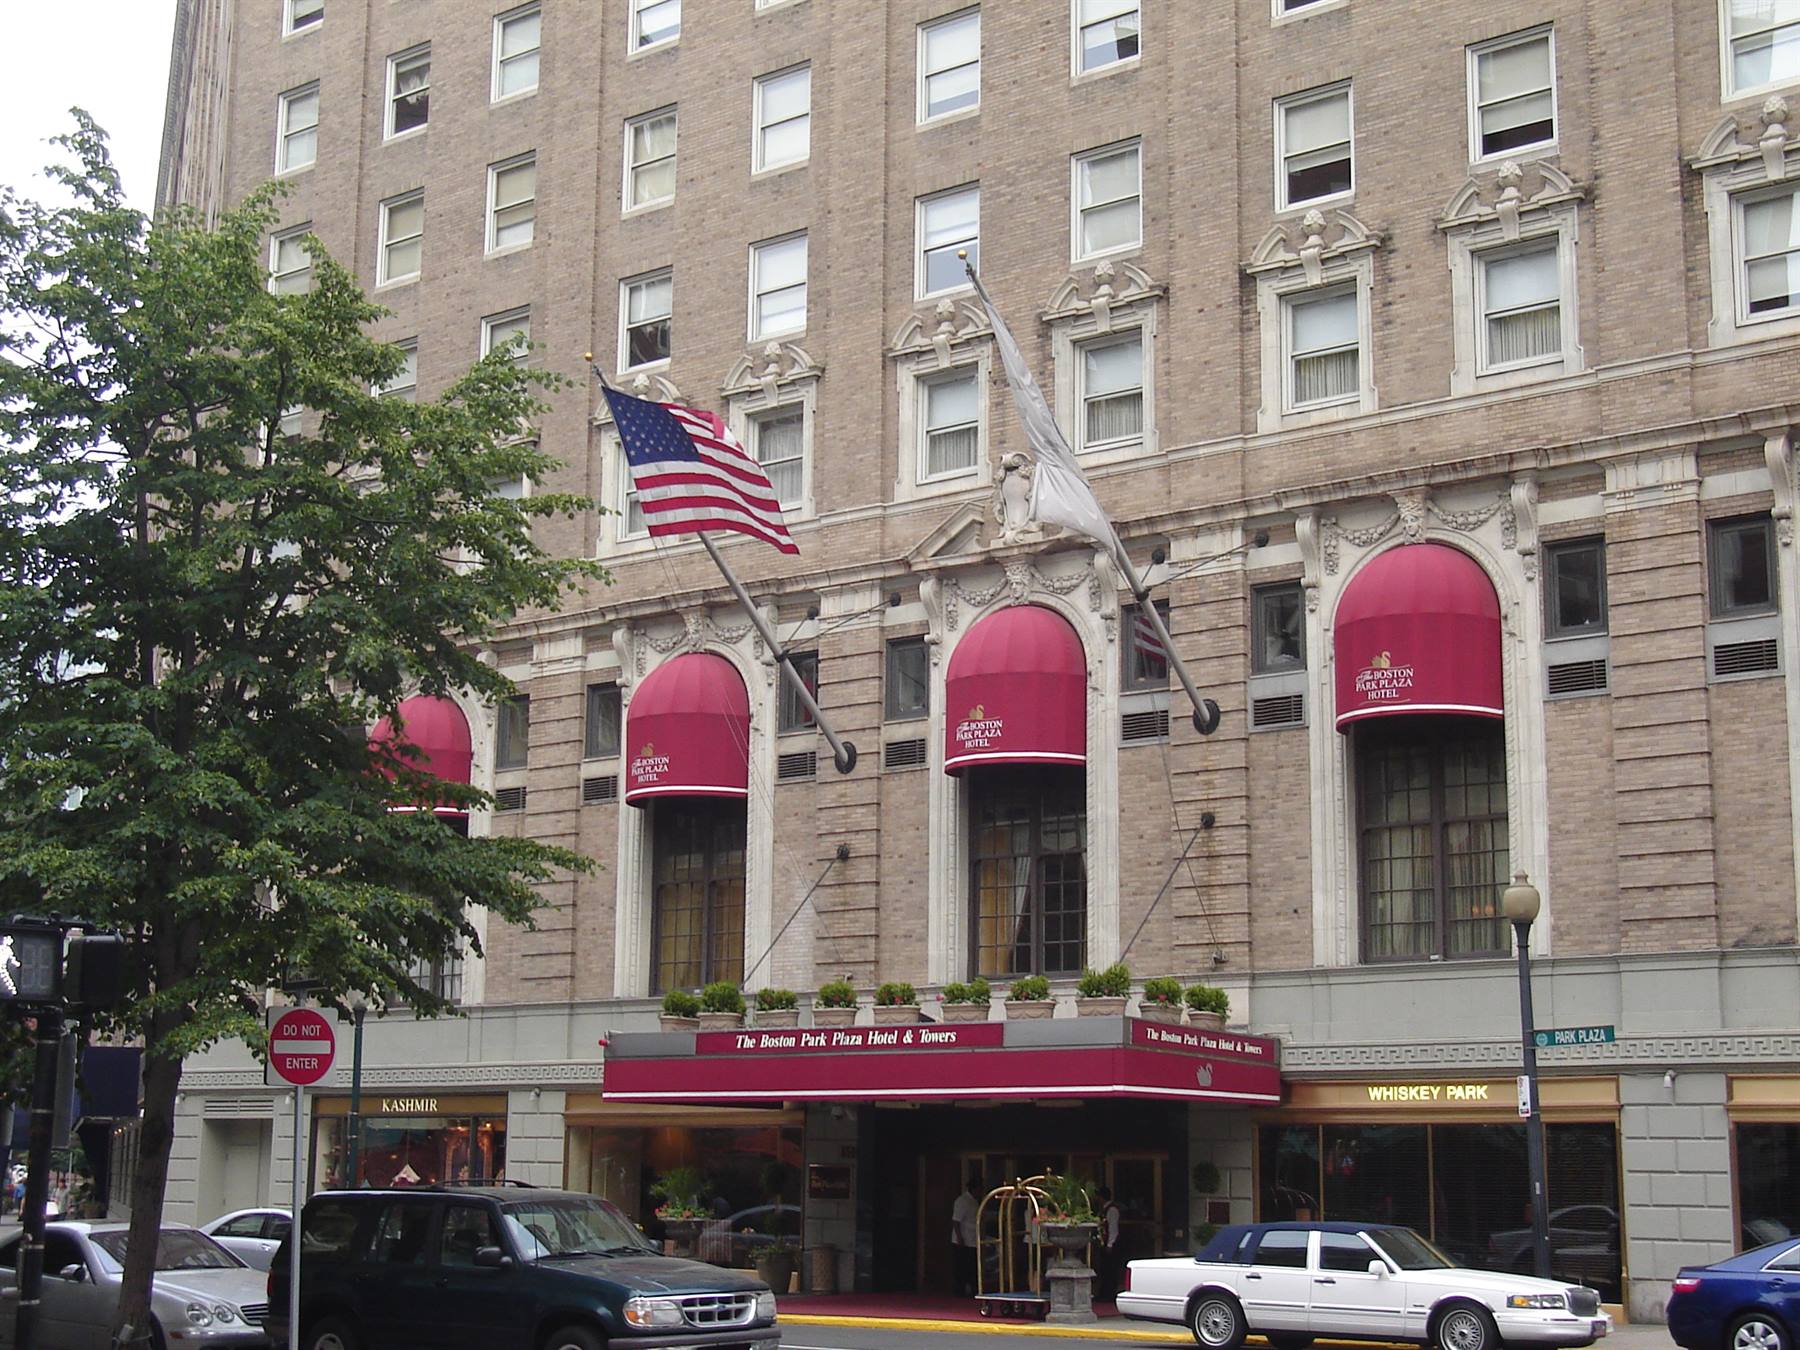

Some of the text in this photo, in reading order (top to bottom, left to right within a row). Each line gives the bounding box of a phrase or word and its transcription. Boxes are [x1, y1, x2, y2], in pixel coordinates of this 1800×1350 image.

[1357, 668, 1414, 682] The BOSTON
[1356, 678, 1413, 692] PARK PLAZA
[1368, 688, 1399, 700] HOTEL
[970, 720, 1003, 731] BOSTON
[956, 729, 1002, 741] PARK PLAZA
[965, 738, 990, 749] HOTEL
[642, 756, 669, 767] BOSTON
[645, 764, 669, 774] PLAZA
[637, 773, 659, 784] HOTEL
[283, 1024, 321, 1036] DO NOT
[1555, 1028, 1606, 1044] PARK PLAZA
[736, 1028, 957, 1049] The Boston Park Plaza Hotel & Towers
[1146, 1028, 1263, 1055] The Boston Park Plaza Hotel & Towers
[286, 1057, 319, 1069] ENTER
[1368, 1085, 1488, 1101] WHISKEY PARK
[382, 1098, 438, 1112] KASHMIR
